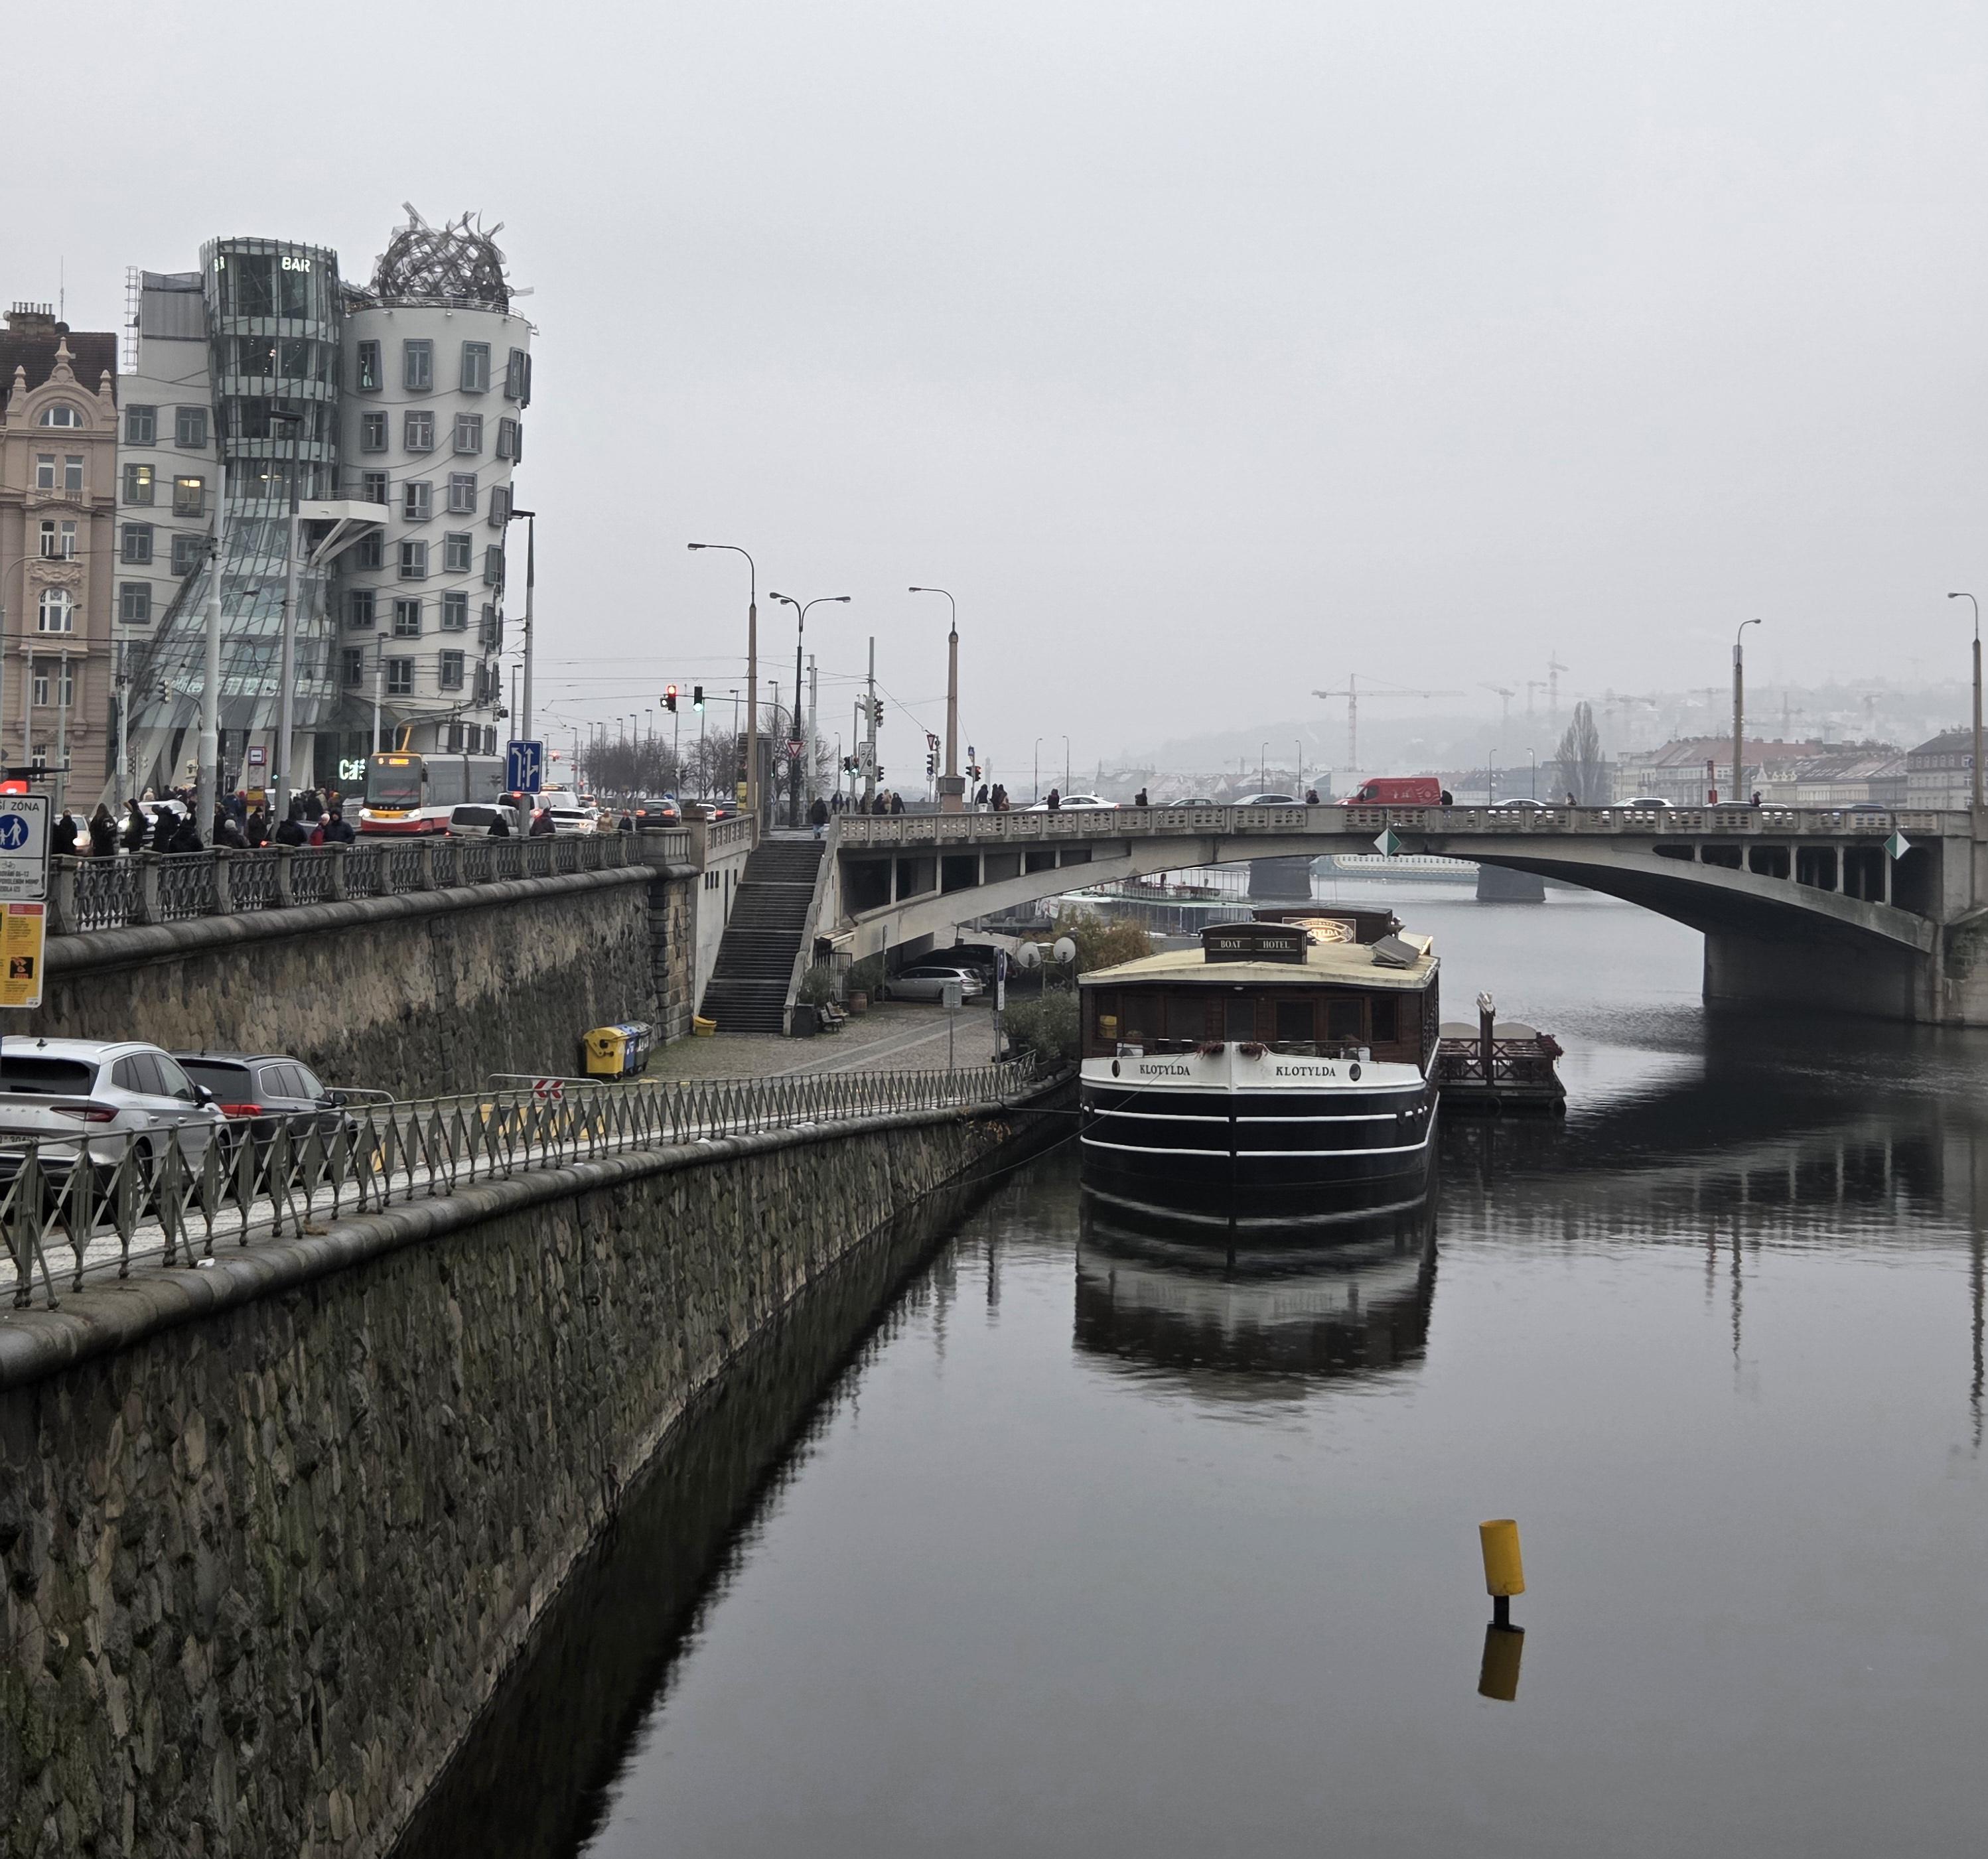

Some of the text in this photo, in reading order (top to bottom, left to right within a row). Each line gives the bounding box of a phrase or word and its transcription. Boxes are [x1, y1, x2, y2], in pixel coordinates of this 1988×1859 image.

[214, 256, 225, 272] BR
[281, 257, 311, 273] BAR
[11, 799, 39, 811] ZÓNA
[1220, 939, 1290, 949] BOAT HOTEL
[1139, 1064, 1190, 1075] KLOTYLDA
[1276, 1066, 1336, 1077] KLOTYLDA
